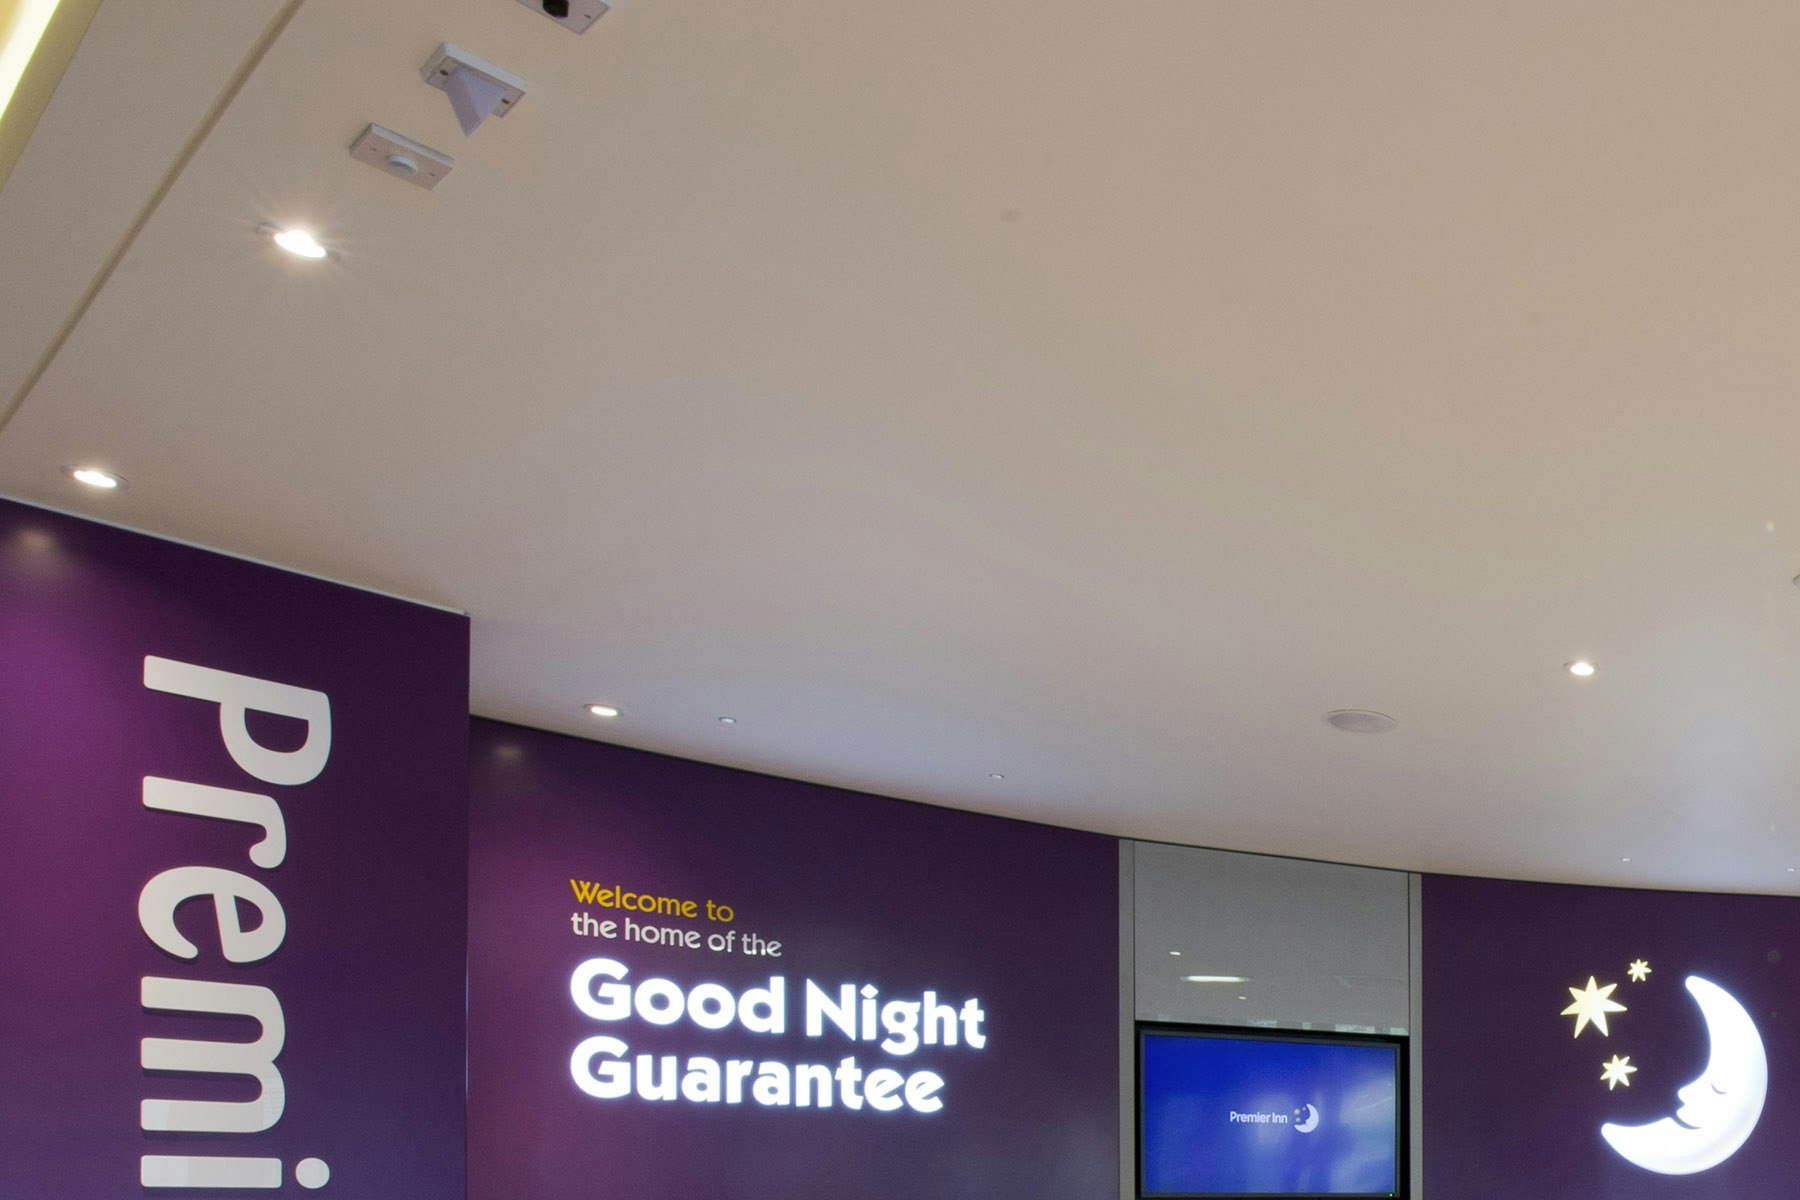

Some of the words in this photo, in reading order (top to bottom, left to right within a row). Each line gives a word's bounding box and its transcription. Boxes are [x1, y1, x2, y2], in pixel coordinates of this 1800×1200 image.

[570, 879, 697, 918] Welcome
[706, 899, 735, 922] to
[570, 912, 617, 938] the
[625, 917, 701, 949] home
[708, 930, 736, 952] of
[741, 933, 783, 958] the
[569, 957, 786, 1034] Good
[806, 977, 987, 1056] Night
[569, 1035, 945, 1113] Guarantee
[1229, 1110, 1271, 1124] Premier
[1272, 1111, 1288, 1124] Inn
